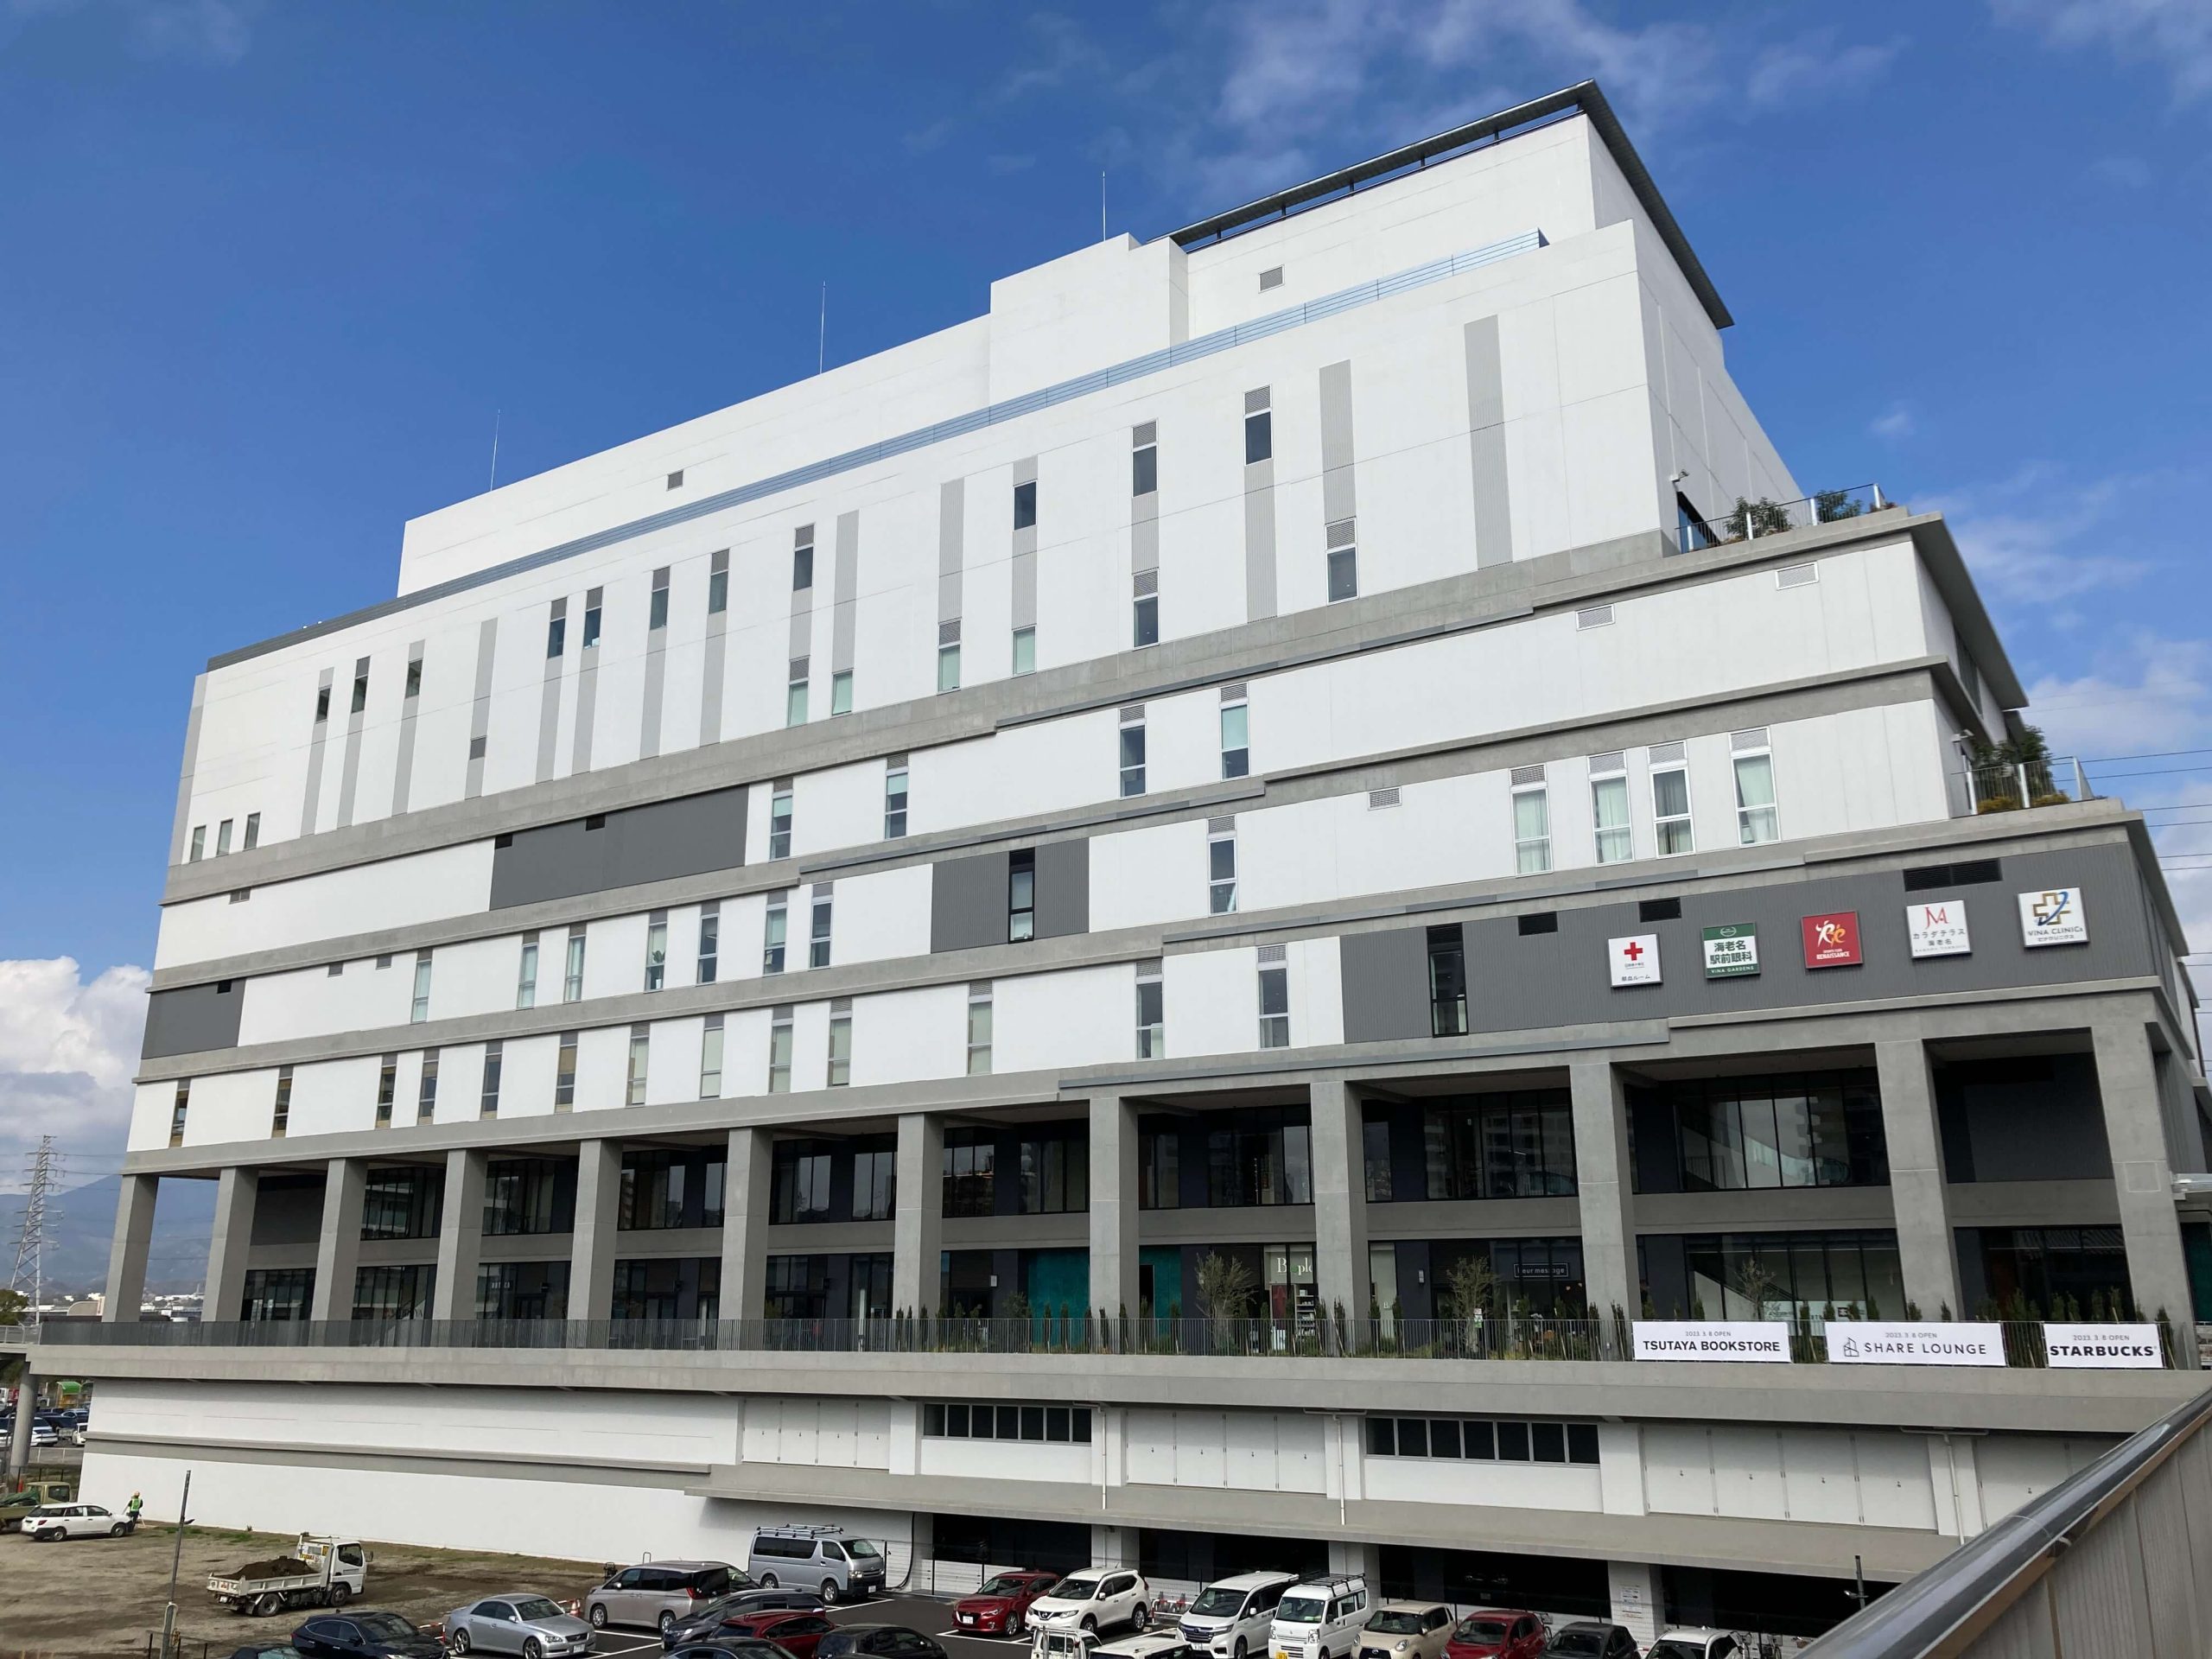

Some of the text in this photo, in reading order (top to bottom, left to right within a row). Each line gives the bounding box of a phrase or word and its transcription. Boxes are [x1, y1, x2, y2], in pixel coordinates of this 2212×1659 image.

[1713, 940, 1746, 952] 海老名
[1710, 951, 1752, 965] 駅前眼科
[1643, 1340, 1782, 1351] TSUTAYA BOOKSTORE
[1864, 1342, 1986, 1355] SHARE LOUNGE
[2050, 1345, 2154, 1357] STARBUCKS
